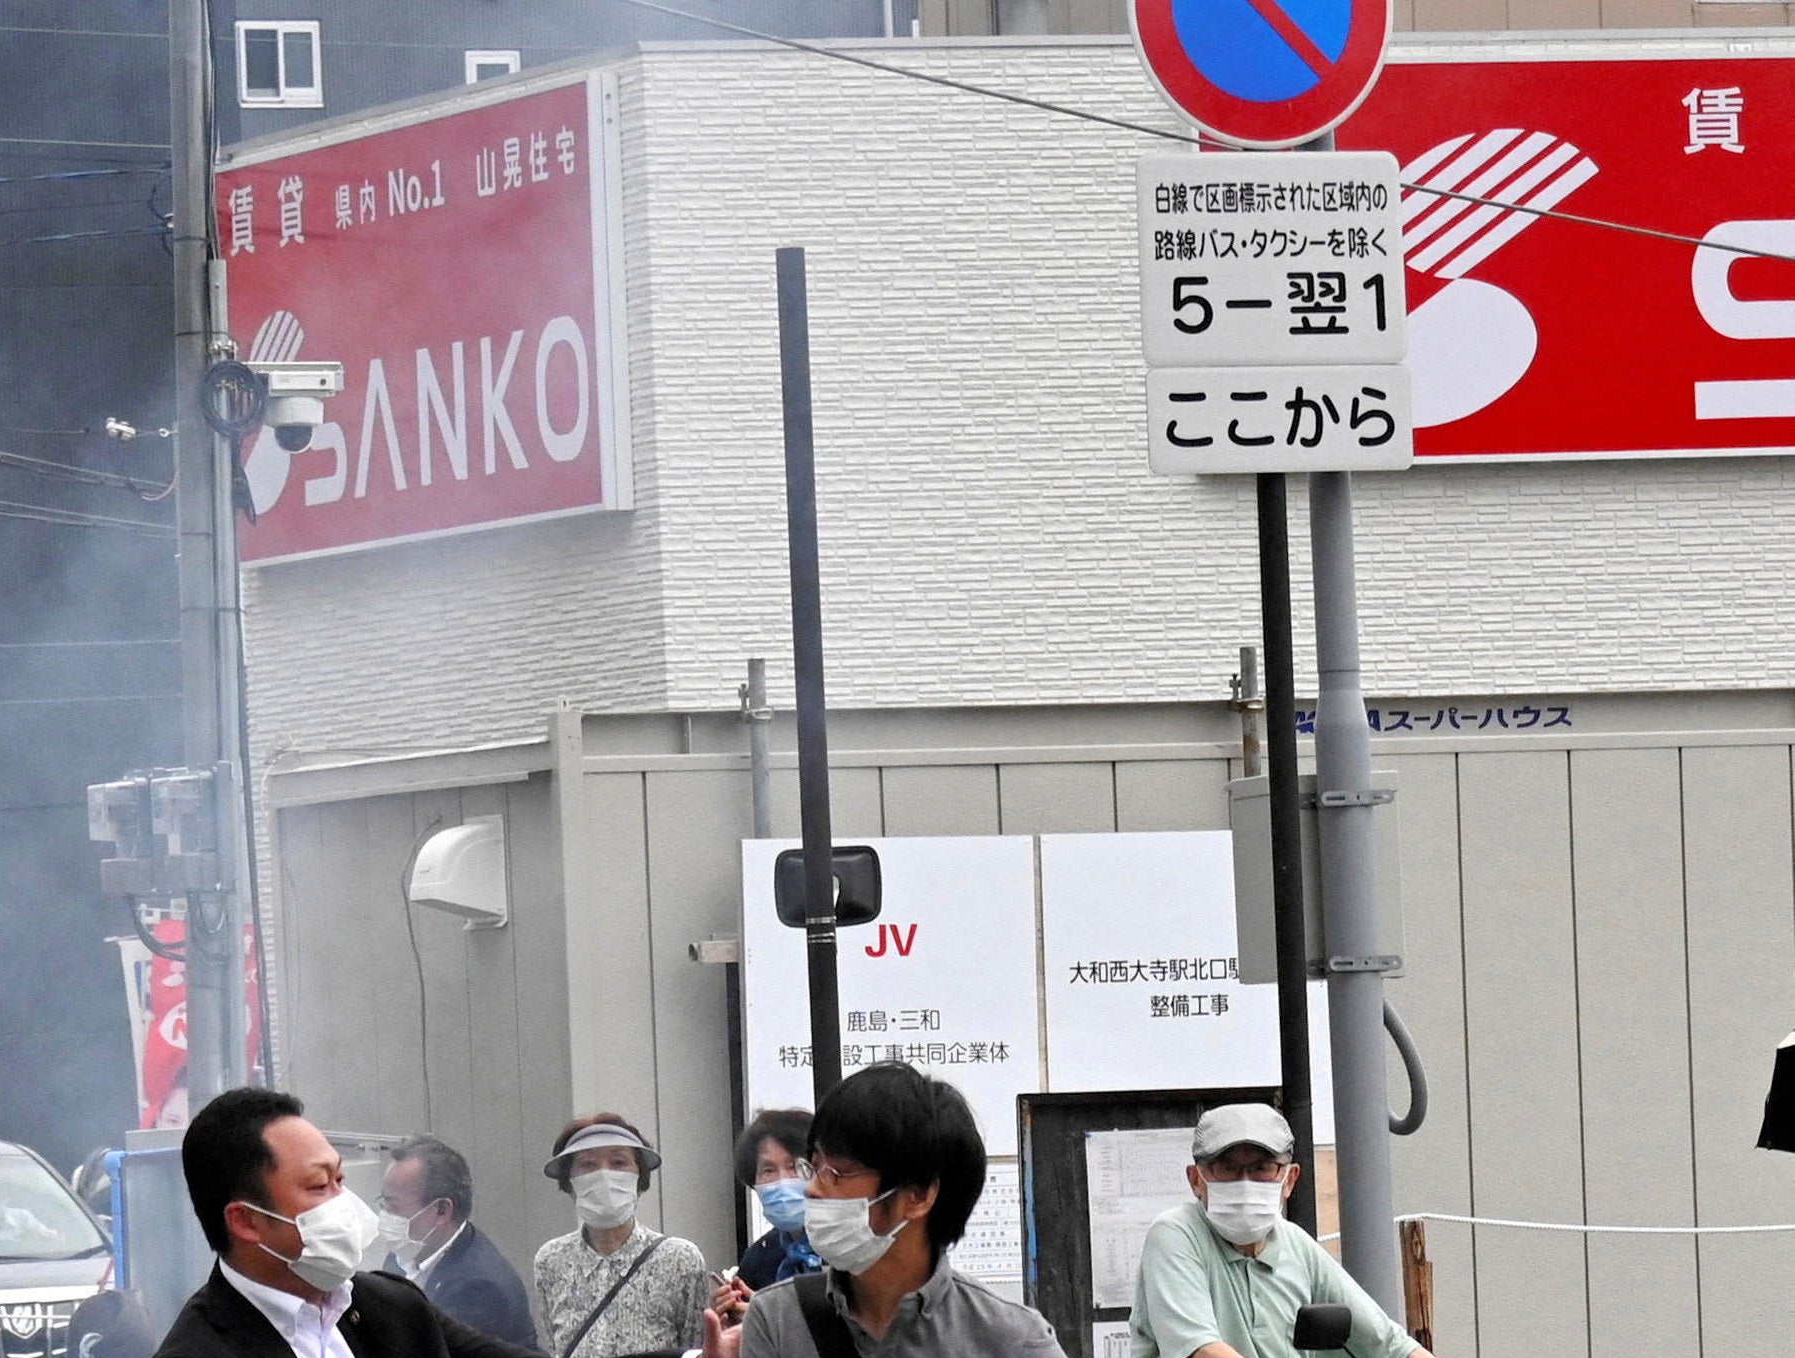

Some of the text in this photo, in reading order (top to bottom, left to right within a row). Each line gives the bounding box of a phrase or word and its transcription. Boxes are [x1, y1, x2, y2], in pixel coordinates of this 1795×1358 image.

[1682, 86, 1746, 154] 賃
[475, 126, 576, 198] 山晃住宅
[1154, 181, 1388, 214] 白線で区画標示された区域内の
[1154, 227, 1388, 261] 路線バス・タクシーを除く
[1166, 386, 1396, 447] ここから
[864, 923, 918, 958] JV
[847, 1009, 941, 1032] 鹿島・三和
[1150, 993, 1229, 1018] 整備工事
[778, 1041, 1011, 1067] 特定設工事共同企業体
